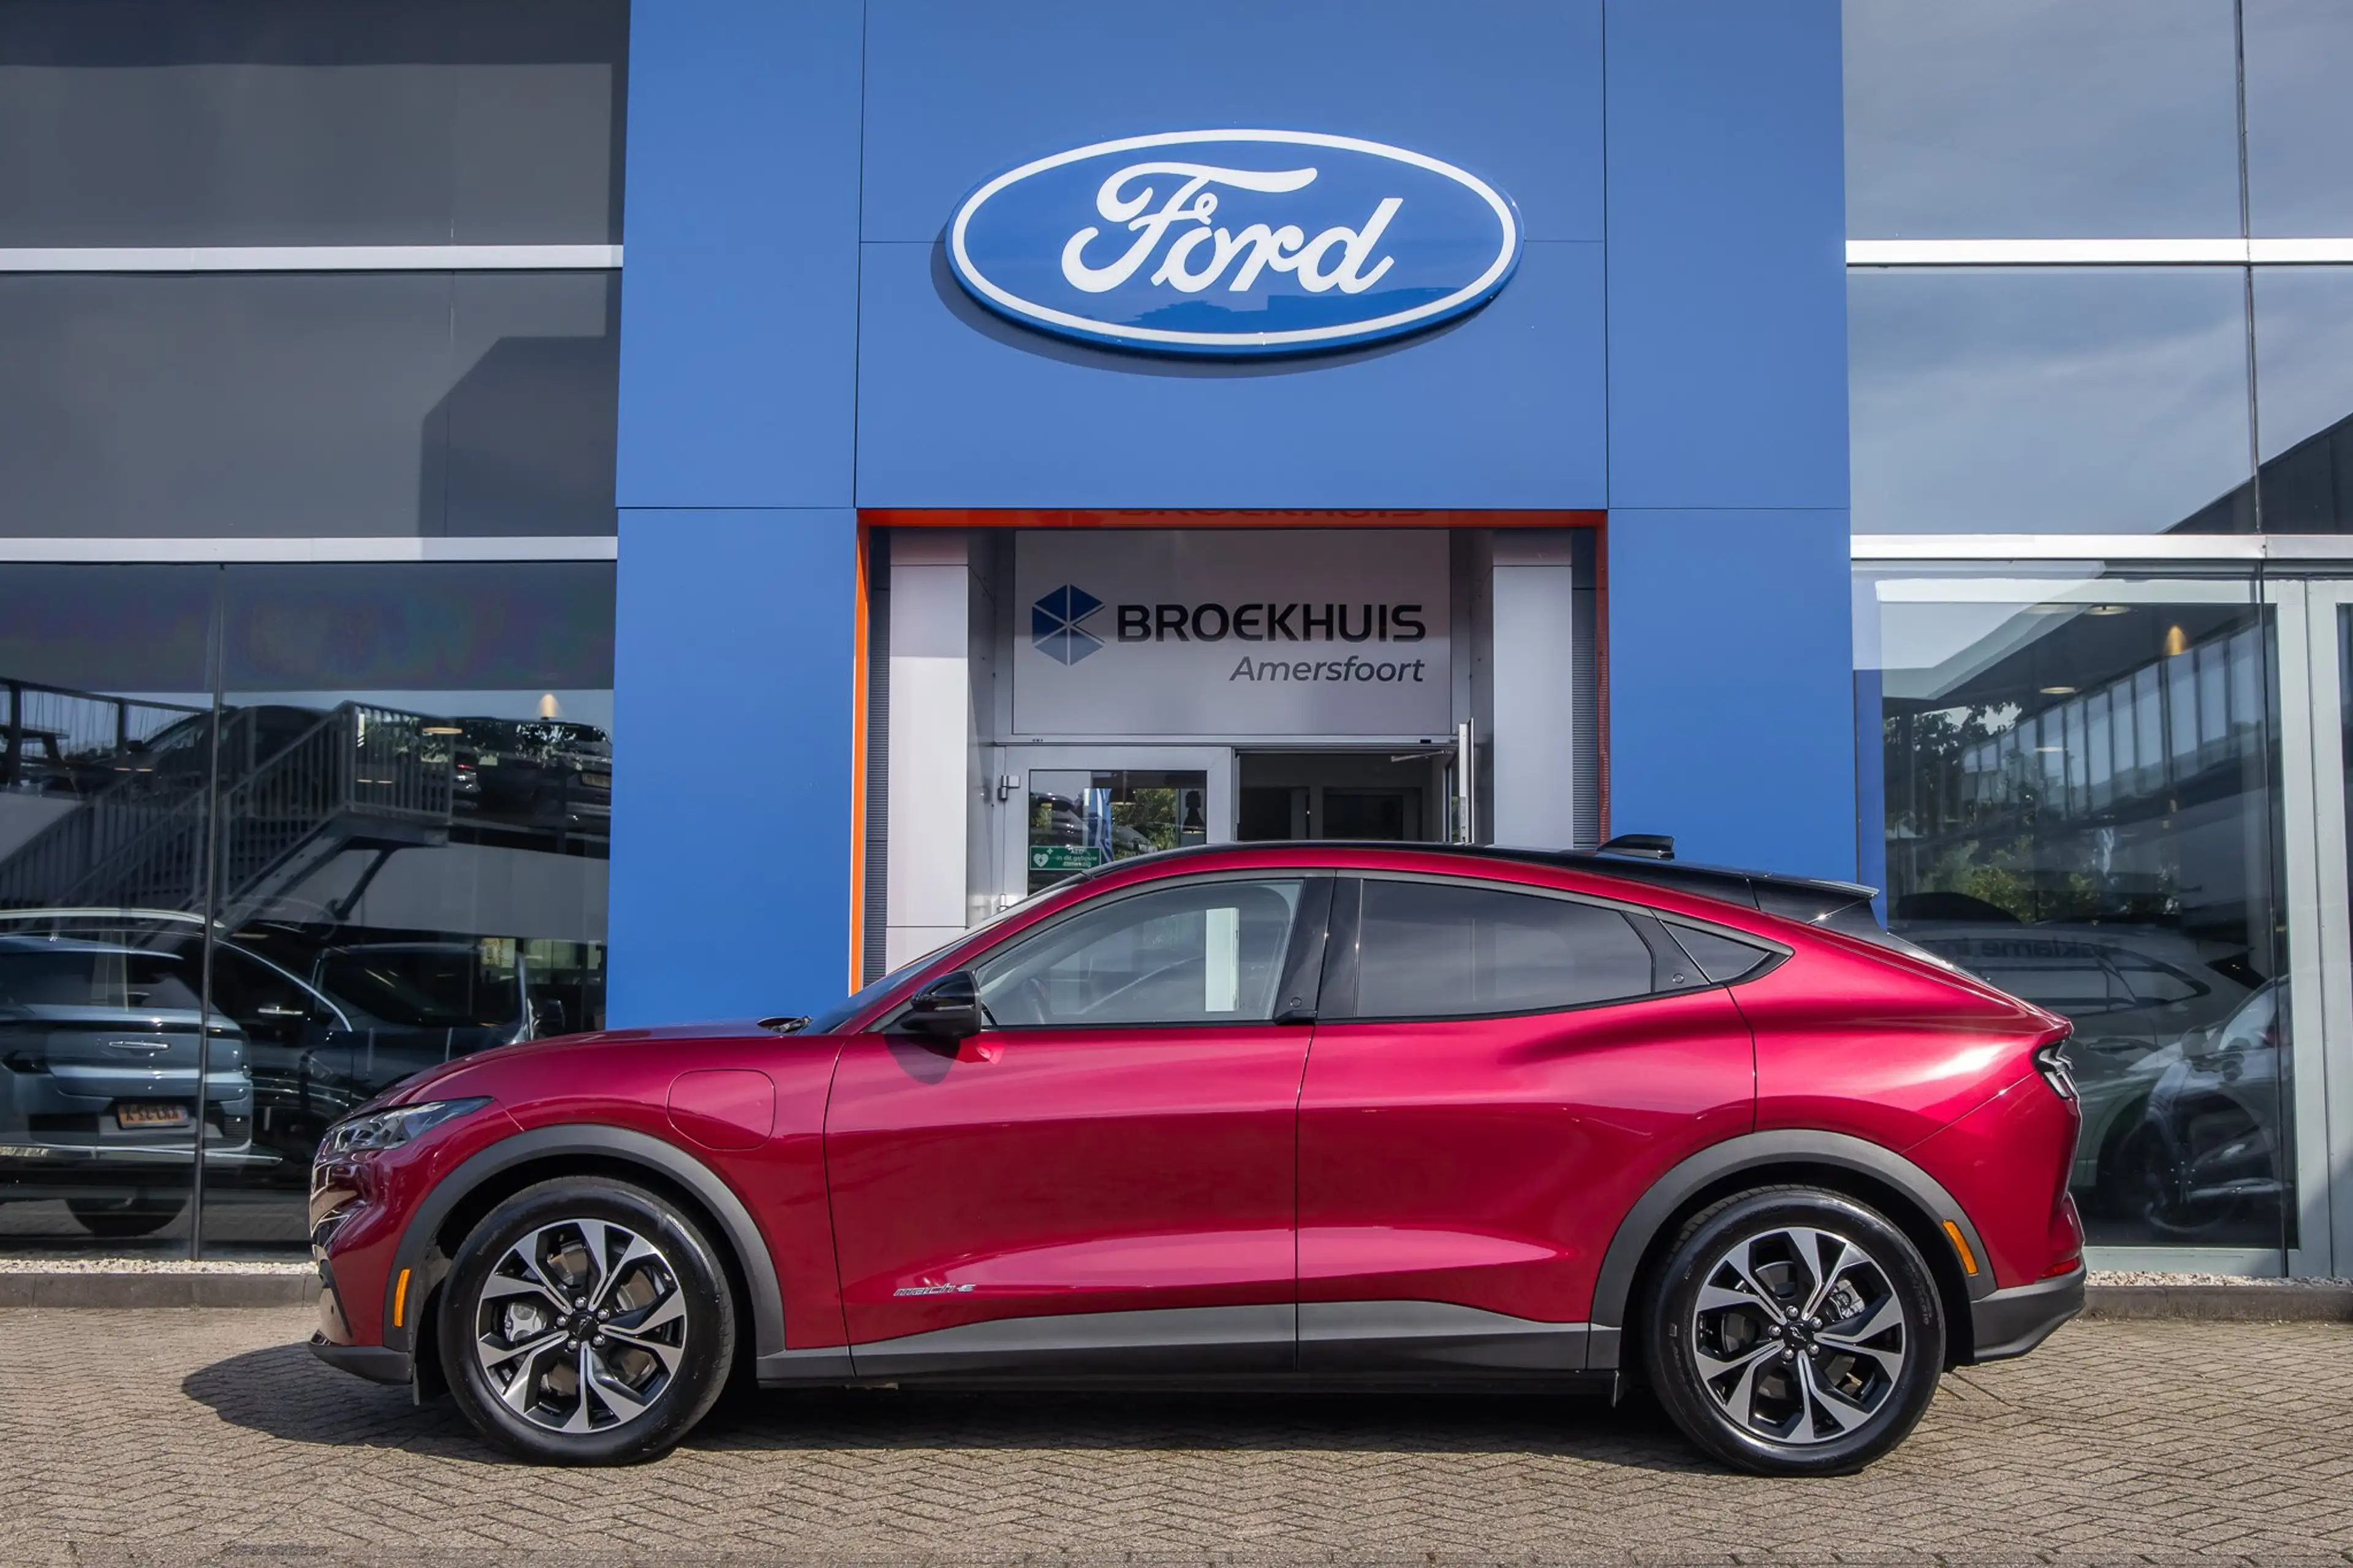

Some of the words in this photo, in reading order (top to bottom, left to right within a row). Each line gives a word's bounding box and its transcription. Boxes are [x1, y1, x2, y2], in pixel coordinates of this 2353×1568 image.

[1061, 162, 1404, 294] Ford
[1118, 603, 1426, 643] BROEKHUIS
[1230, 655, 1425, 682] Amersfoort
